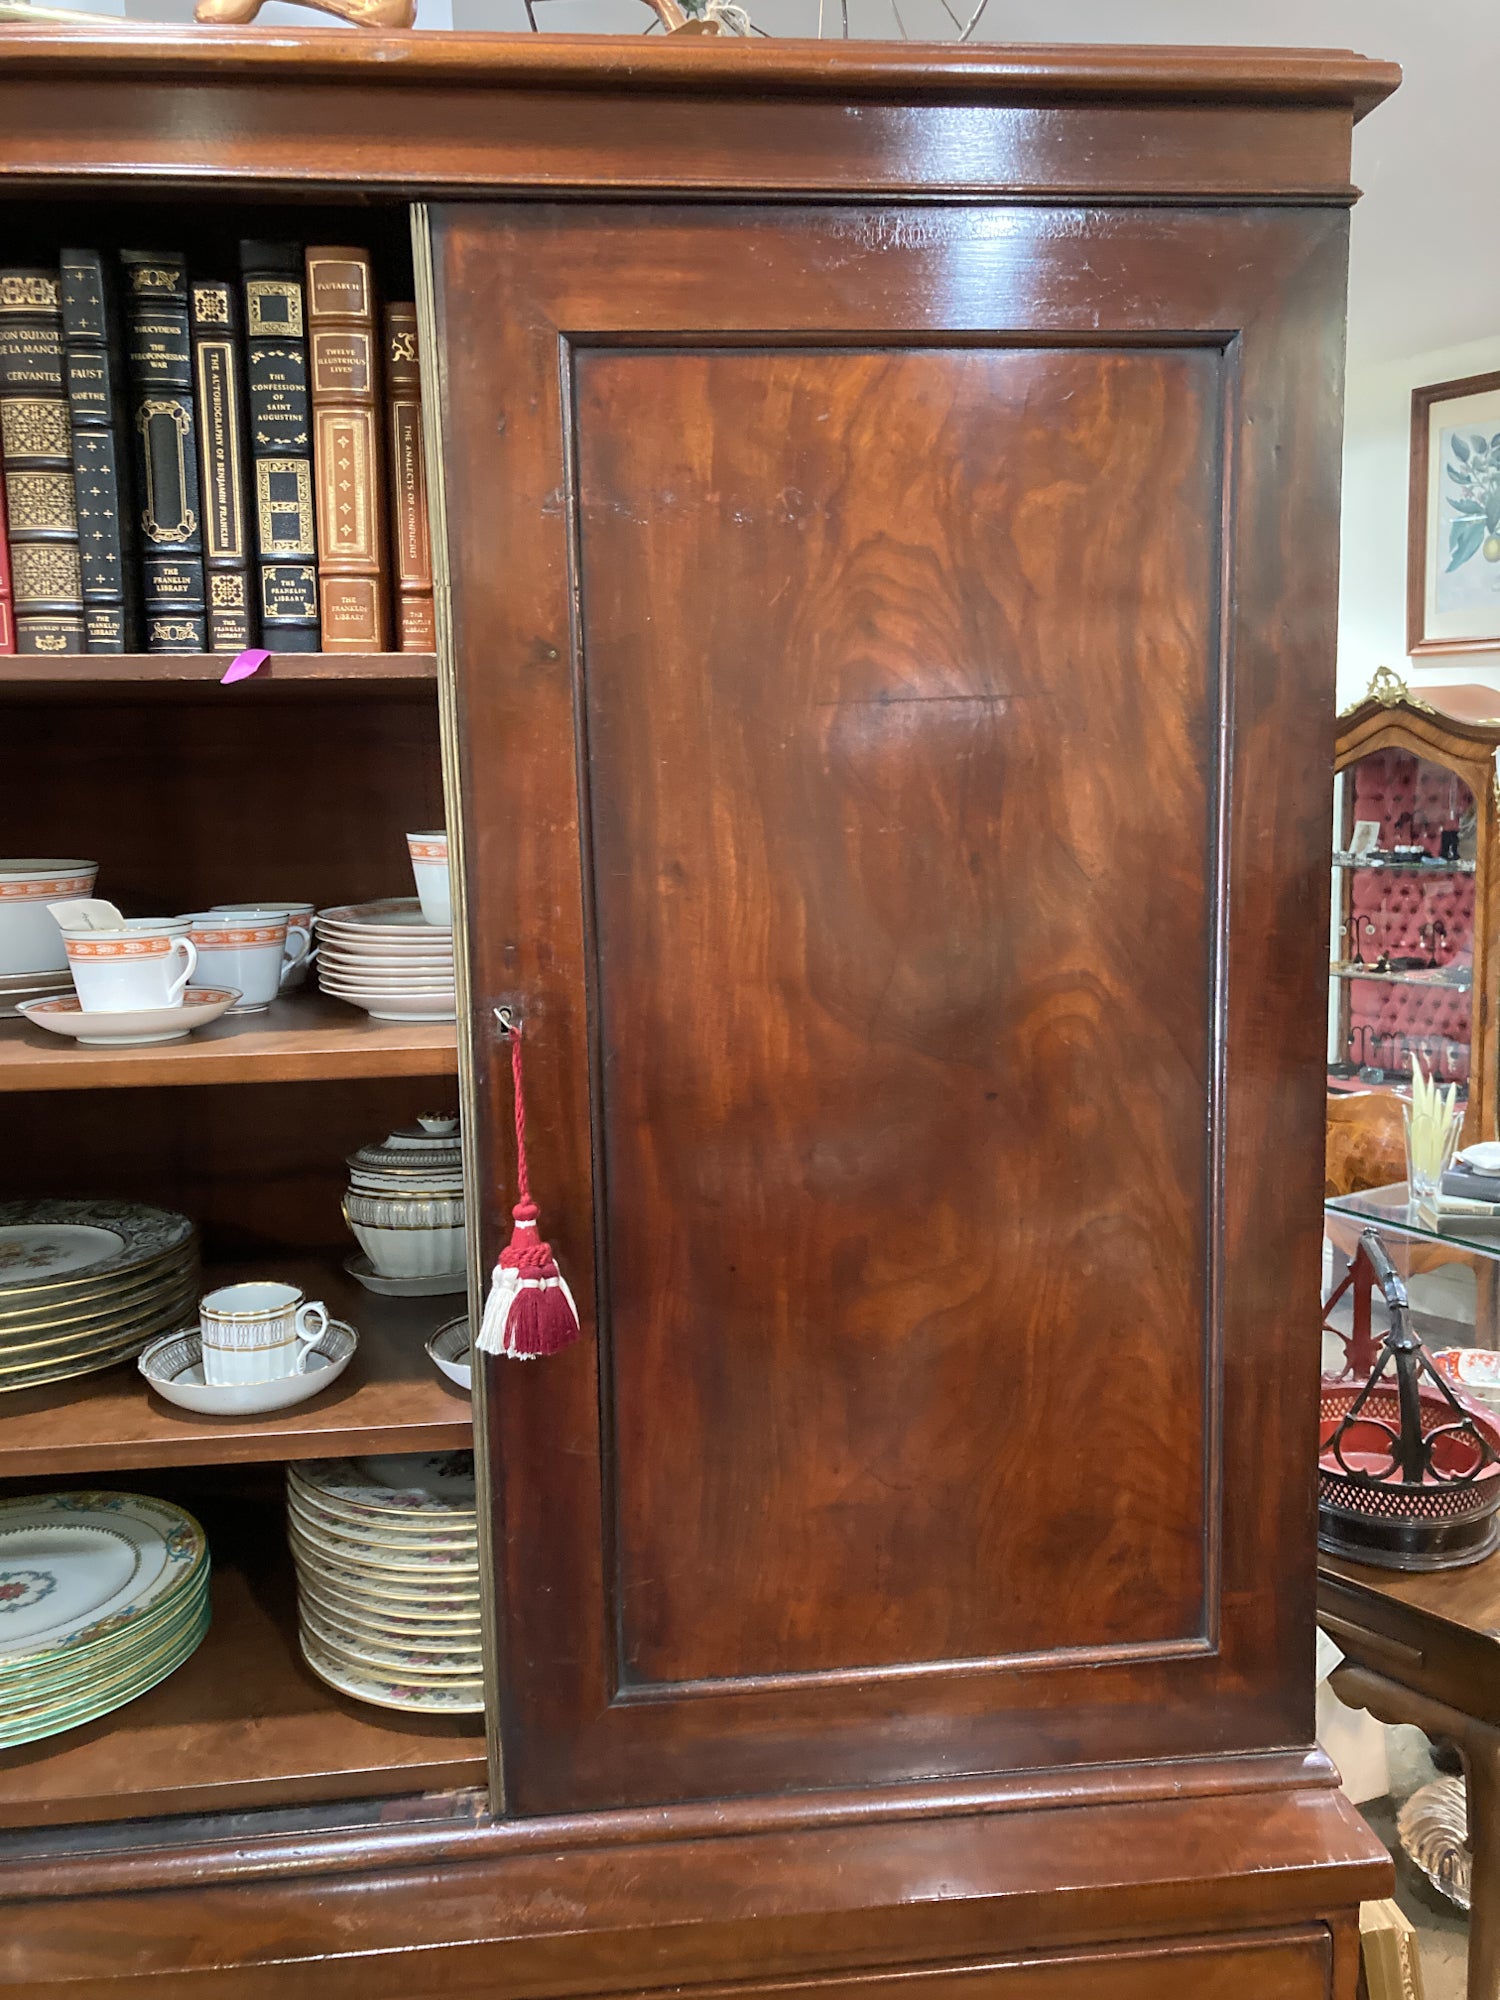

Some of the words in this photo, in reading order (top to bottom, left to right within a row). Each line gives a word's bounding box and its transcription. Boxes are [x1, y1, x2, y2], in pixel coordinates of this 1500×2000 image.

[9, 345, 21, 354] LA
[325, 349, 356, 357] TWELVE
[150, 361, 168, 369] WAR
[318, 359, 366, 367] ILLUSTRIOUS
[7, 372, 62, 382] CERVANTES
[71, 370, 104, 379] FAUST
[269, 373, 286, 381] THE
[252, 383, 306, 392] CONFESSIONS
[72, 392, 105, 401] GOETHE
[273, 393, 284, 401] OF
[266, 404, 291, 412] SAINT
[257, 414, 303, 422] AUGUSTINE
[211, 353, 220, 371] THE
[216, 462, 226, 504] BENJAMIN
[404, 425, 412, 441] THE
[163, 568, 179, 576] THE
[153, 576, 191, 584] FRANKLIN
[157, 584, 189, 592] LIBRARY
[332, 605, 368, 613] FRANKLIN
